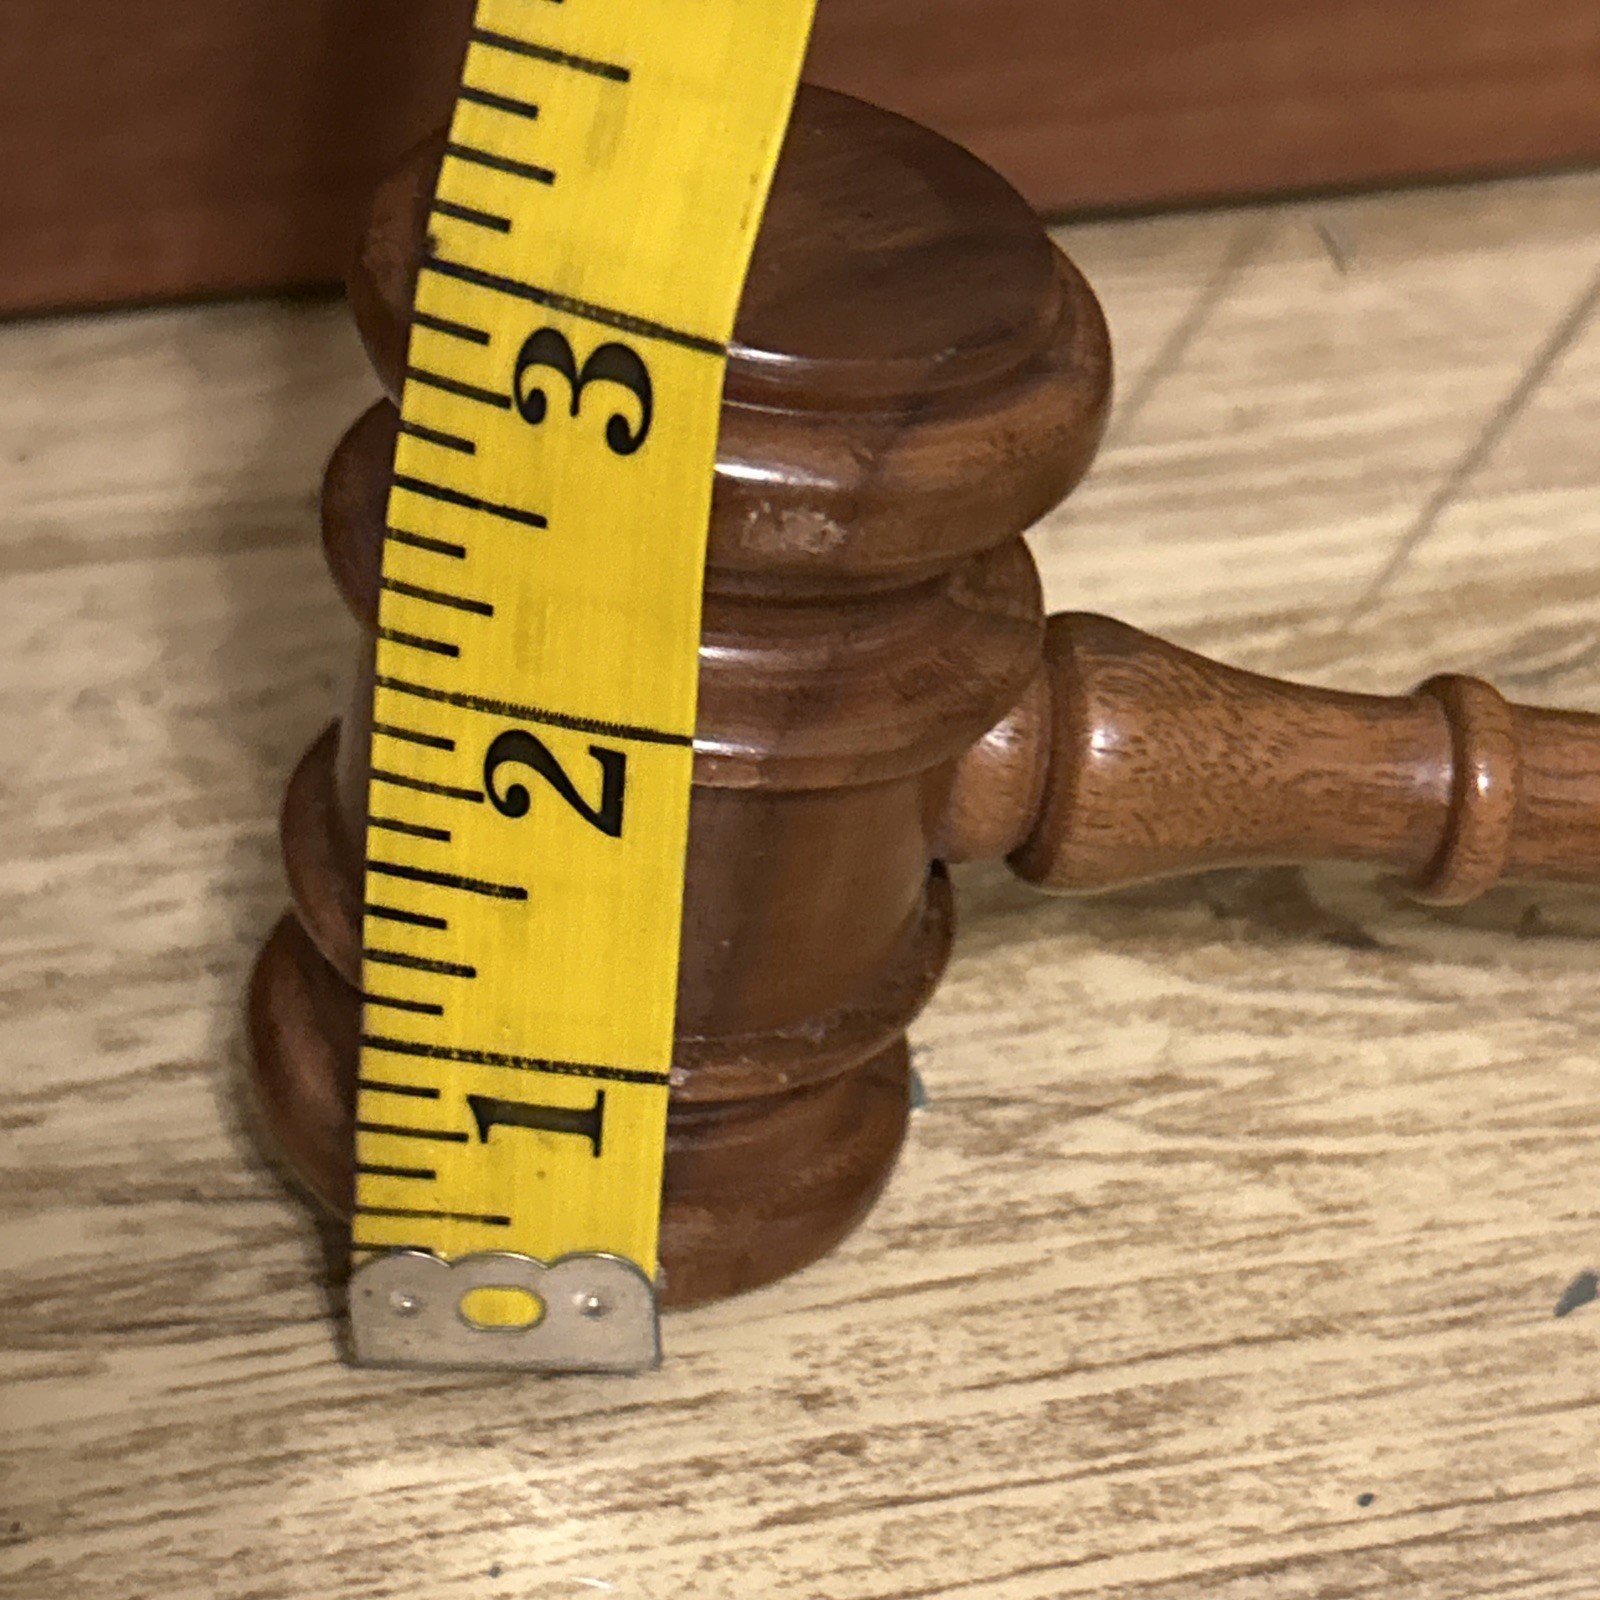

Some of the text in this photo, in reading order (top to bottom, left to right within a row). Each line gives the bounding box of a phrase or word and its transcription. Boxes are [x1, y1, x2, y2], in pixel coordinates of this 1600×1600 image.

[513, 327, 653, 456] 3
[483, 729, 627, 838] 2
[467, 1089, 605, 1158] 1
